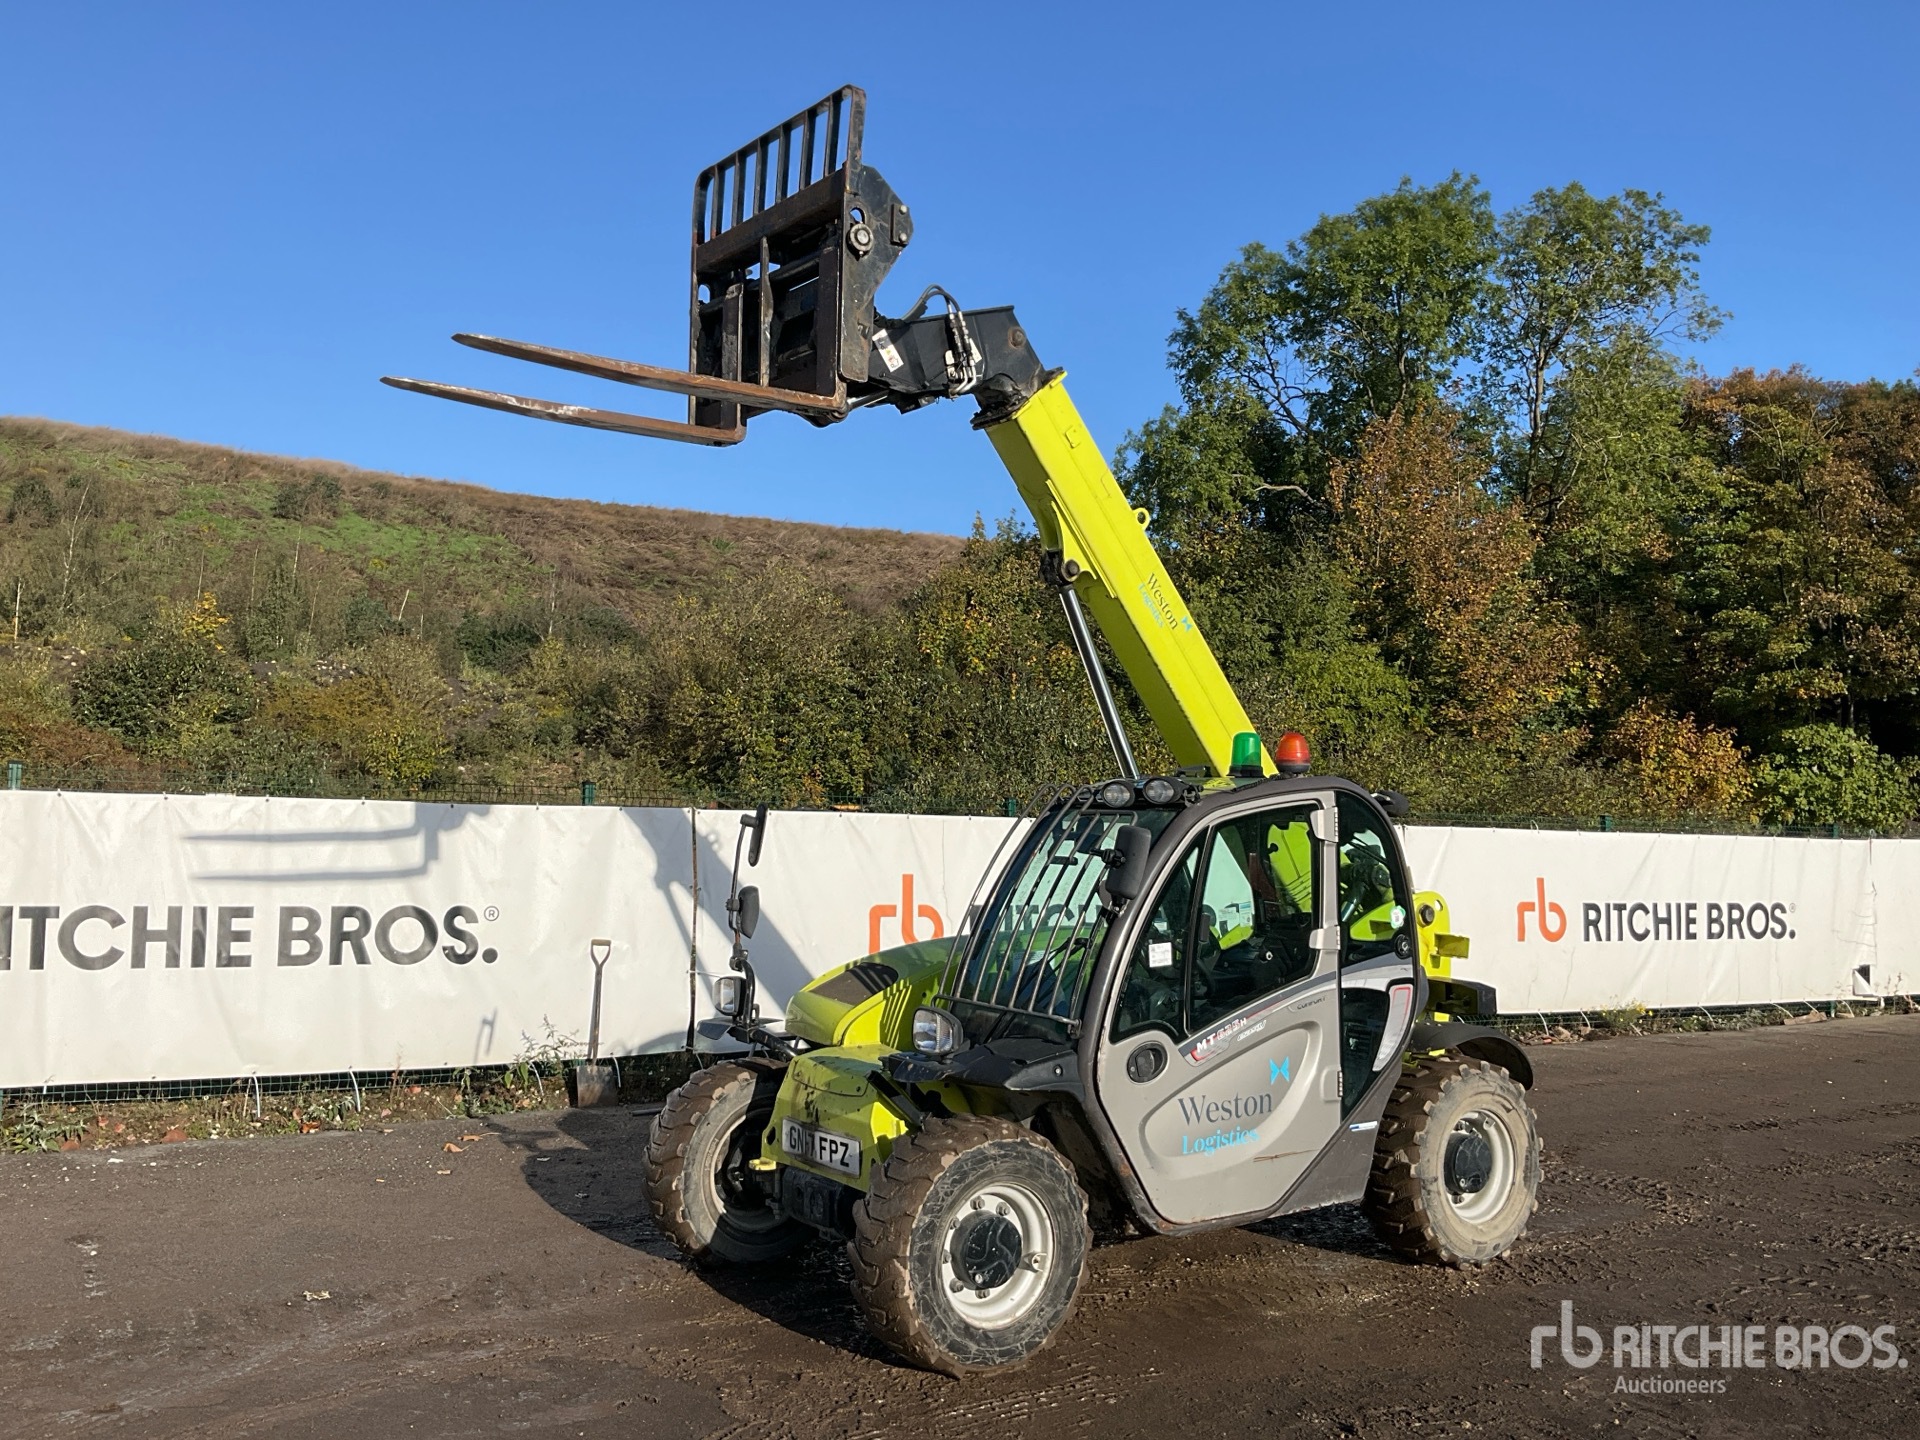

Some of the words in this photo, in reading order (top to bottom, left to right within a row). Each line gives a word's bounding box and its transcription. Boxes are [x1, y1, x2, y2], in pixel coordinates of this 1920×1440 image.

[1147, 573, 1178, 630] Weston
[1516, 877, 1567, 942] rb
[1582, 902, 1697, 942] RITCHIE
[1177, 1091, 1272, 1126] Weston
[819, 1136, 849, 1168] FPZ
[1181, 1125, 1261, 1157] Logistics
